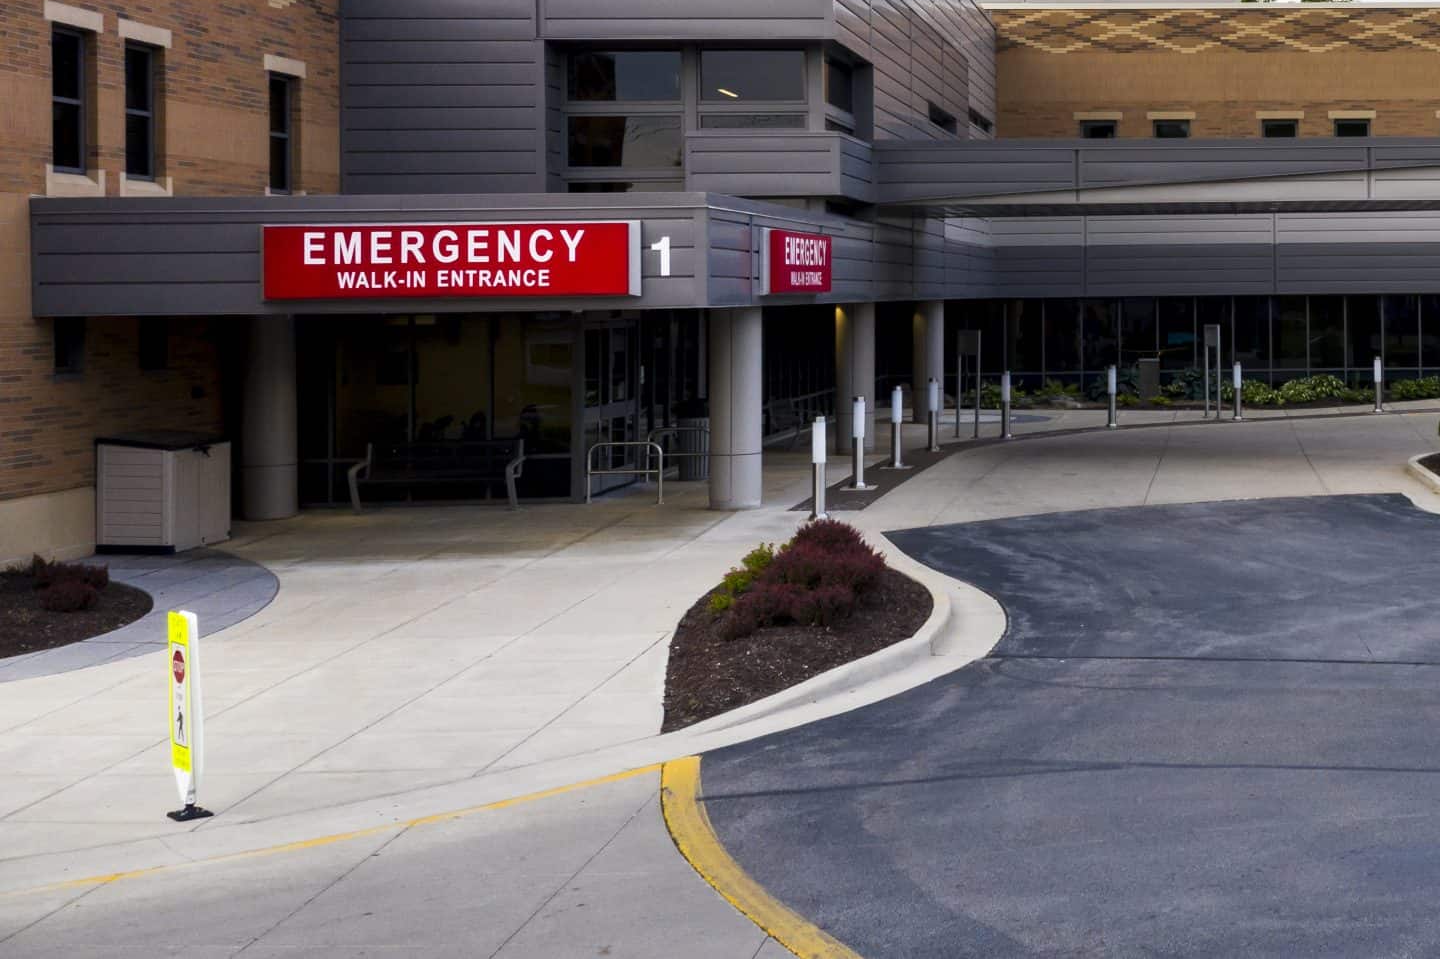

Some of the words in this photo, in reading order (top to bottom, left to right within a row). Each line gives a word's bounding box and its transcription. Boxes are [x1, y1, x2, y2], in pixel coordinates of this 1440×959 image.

[303, 229, 585, 265] EMERGENCY
[651, 236, 671, 276] 1
[785, 236, 827, 266] EMERGENCY
[337, 269, 427, 289] WALK-IN
[437, 269, 551, 288] ENTRANCE
